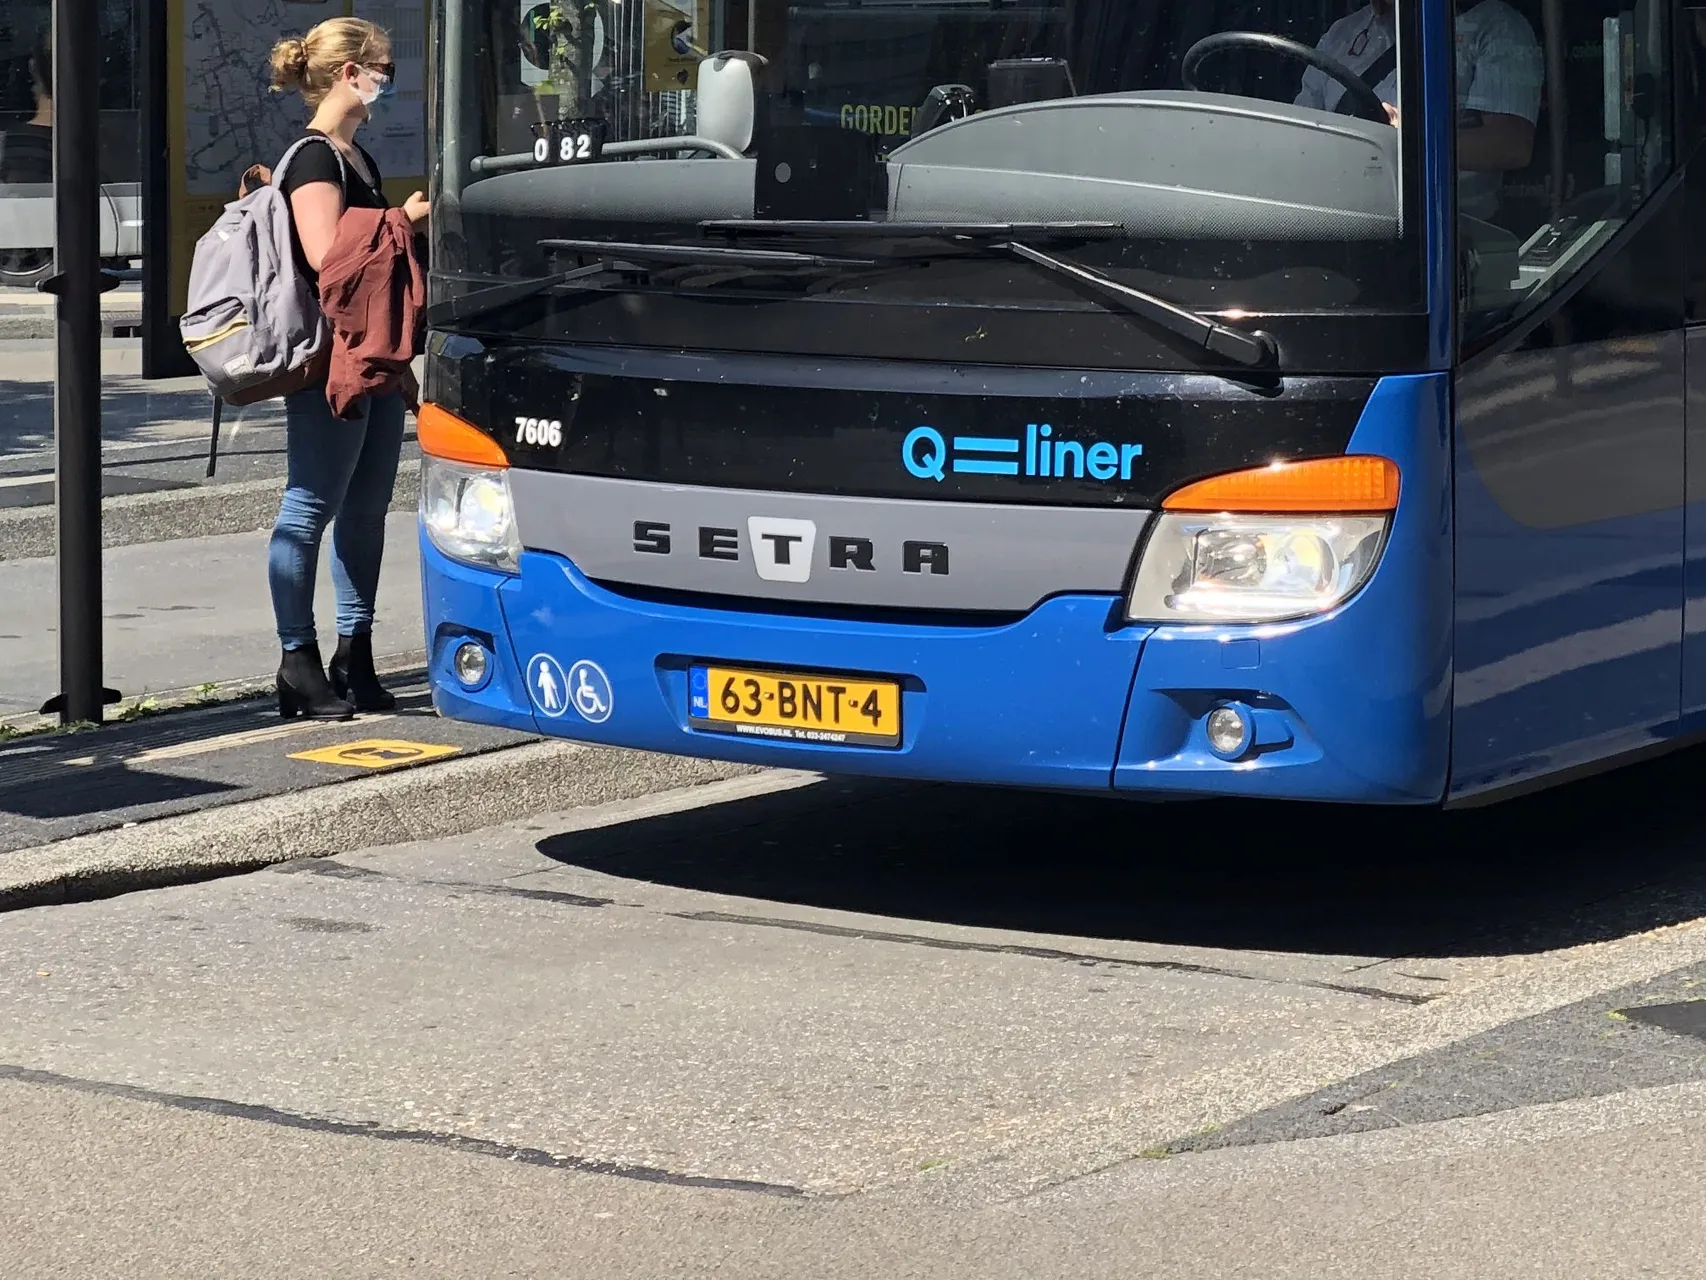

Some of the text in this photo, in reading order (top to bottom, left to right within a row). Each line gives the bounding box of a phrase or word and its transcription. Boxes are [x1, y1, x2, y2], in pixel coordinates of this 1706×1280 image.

[840, 104, 918, 135] GORDE
[515, 416, 562, 447] 7606
[633, 520, 950, 576] SETRA
[693, 677, 882, 727] NL 63-BNT-4
[736, 724, 793, 738] WWW.EVOBUS.NL
